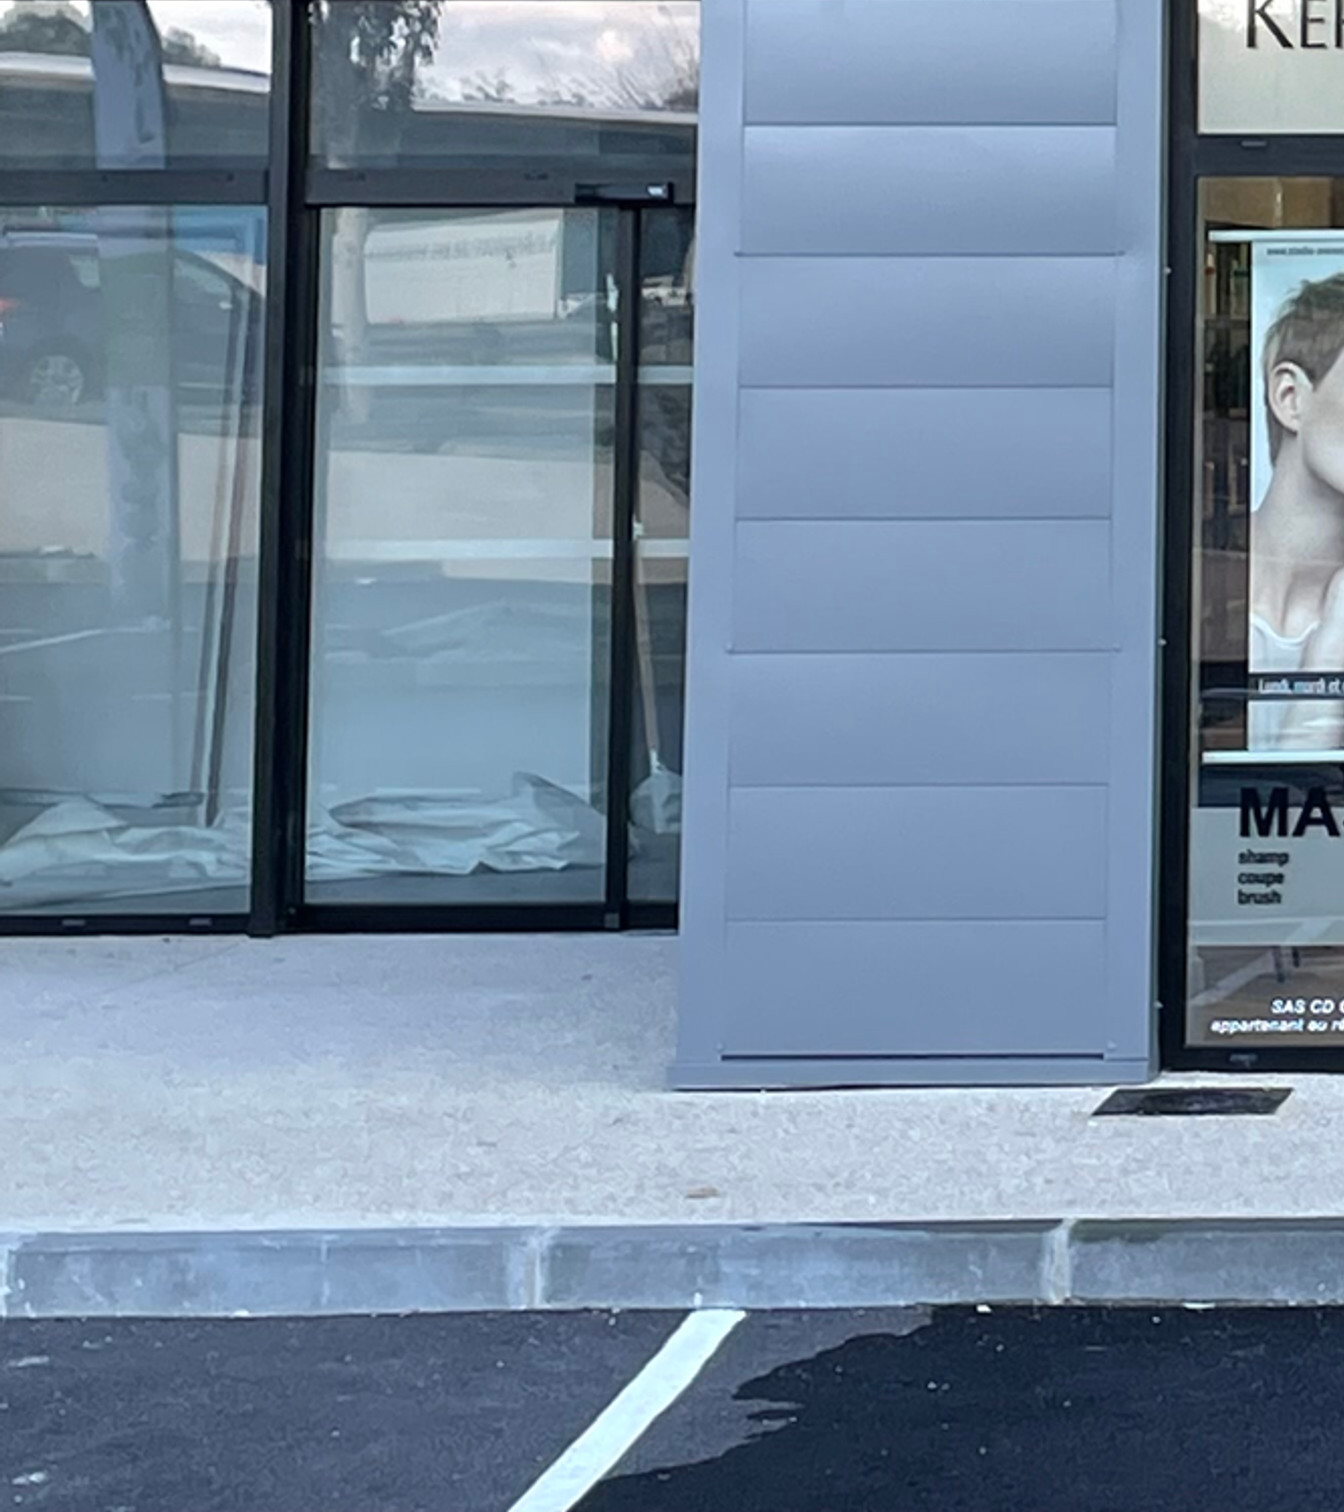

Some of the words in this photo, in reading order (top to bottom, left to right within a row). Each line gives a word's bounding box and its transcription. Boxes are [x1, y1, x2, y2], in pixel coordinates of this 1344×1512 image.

[1238, 849, 1289, 867] shamp
[1238, 871, 1285, 887] coupe
[1238, 890, 1282, 905] brush
[1271, 999, 1306, 1014] SAS
[1210, 1018, 1305, 1035] appartenant
